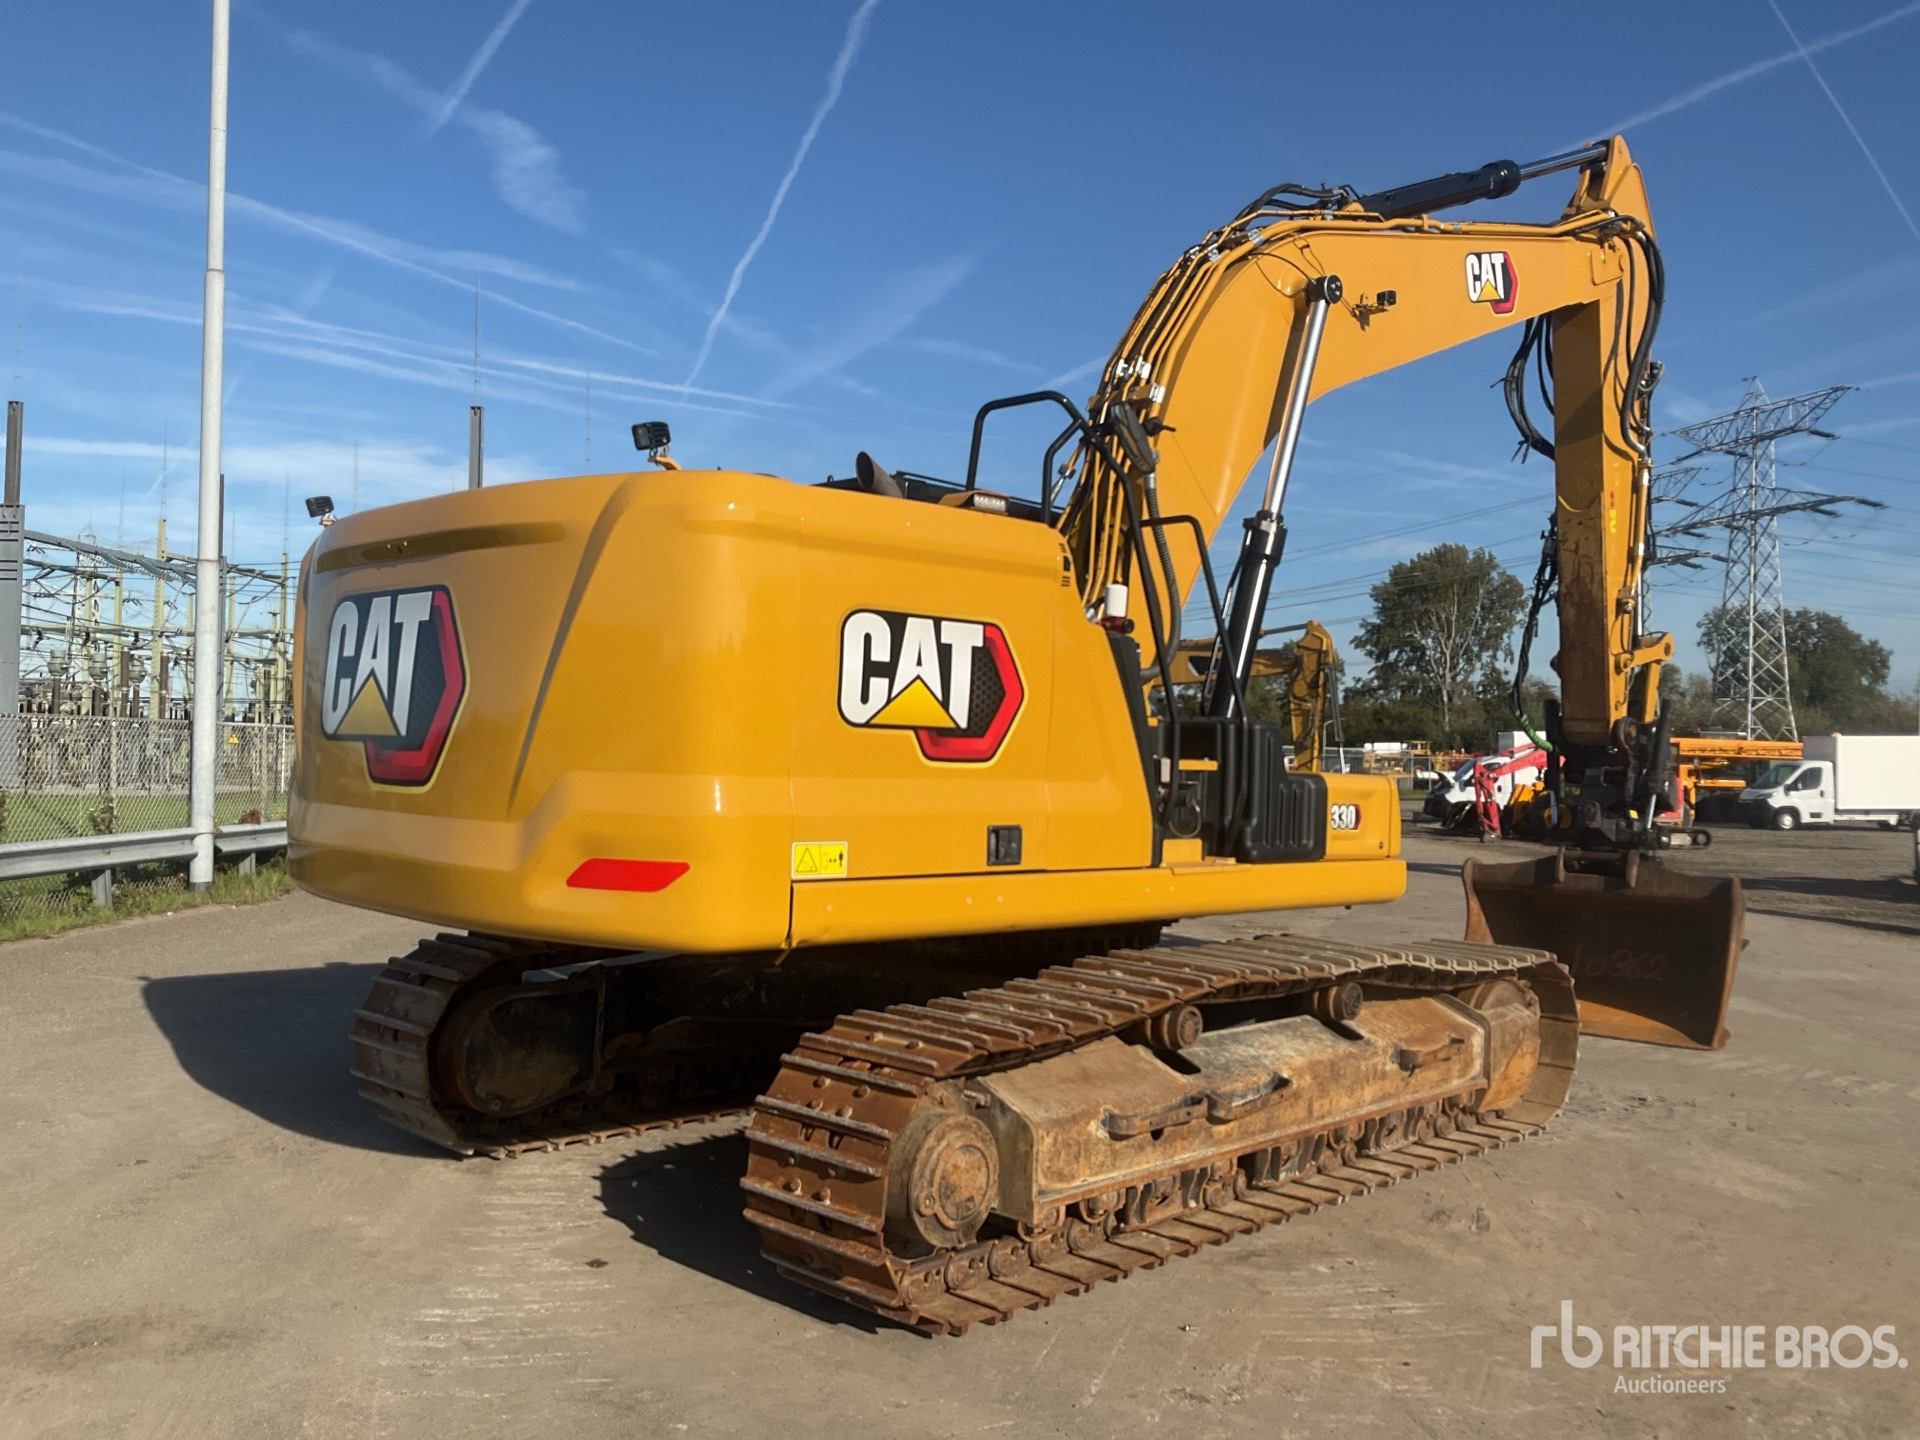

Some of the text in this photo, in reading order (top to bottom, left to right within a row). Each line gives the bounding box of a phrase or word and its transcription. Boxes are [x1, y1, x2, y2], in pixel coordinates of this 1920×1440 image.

[1466, 252, 1504, 302] CAT
[322, 591, 433, 737] CAT
[840, 612, 984, 729] CAT
[1331, 804, 1356, 829] 330
